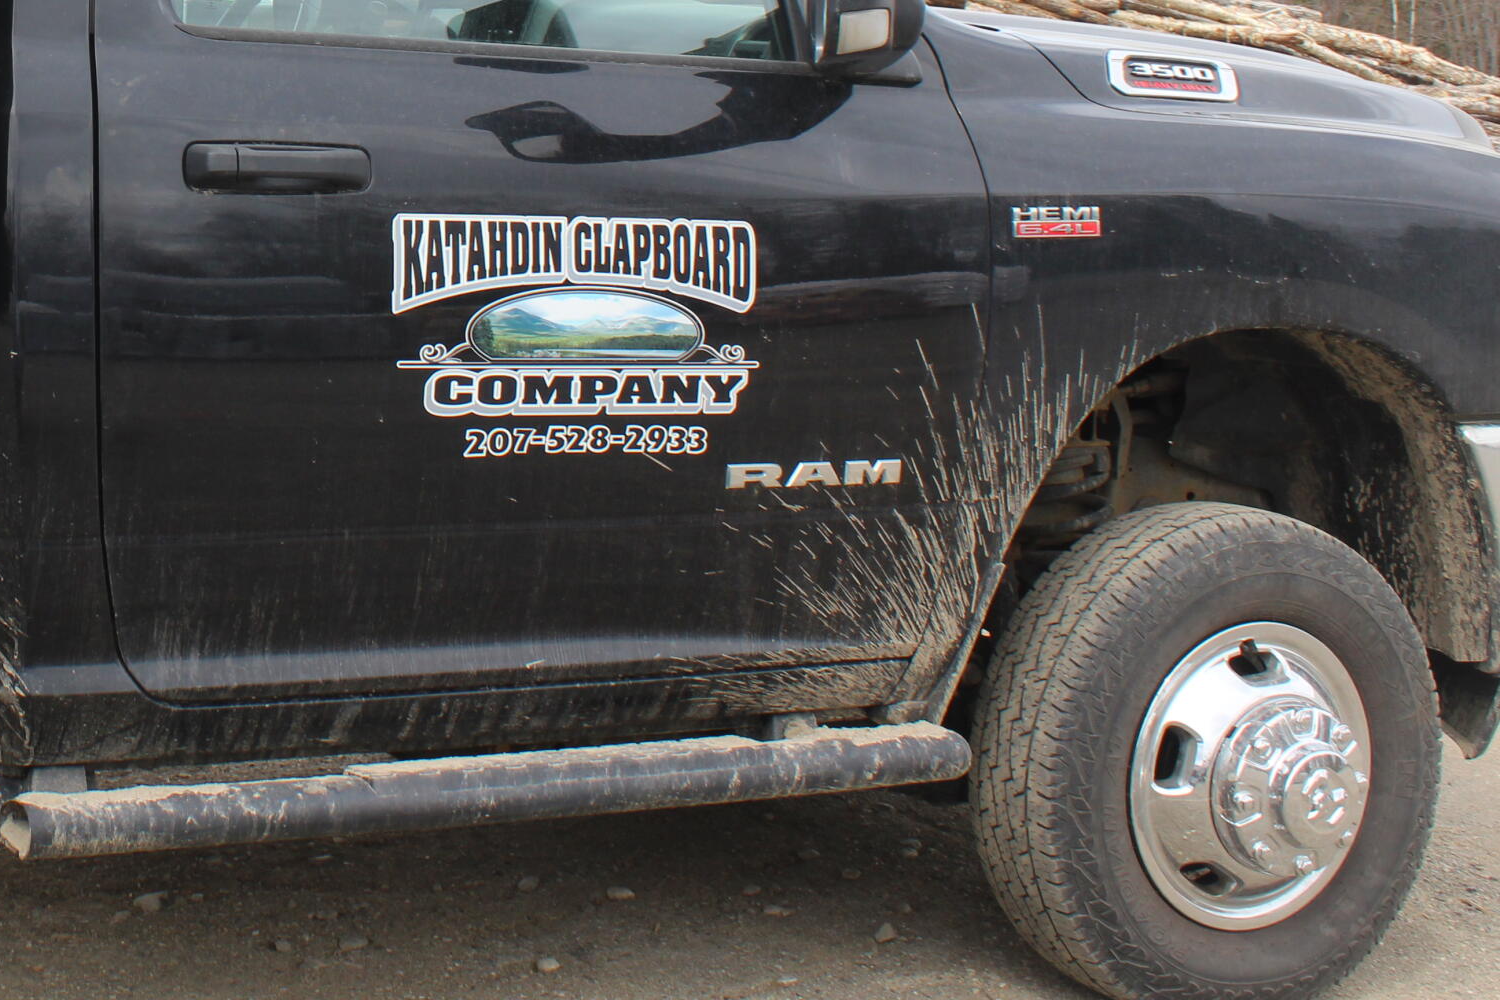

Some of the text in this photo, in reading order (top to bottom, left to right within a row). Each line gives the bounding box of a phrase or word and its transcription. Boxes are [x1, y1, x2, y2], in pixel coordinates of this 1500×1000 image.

[1128, 61, 1216, 83] 3500
[1011, 206, 1100, 222] HEMI
[1018, 223, 1096, 235] 6.4L
[397, 216, 753, 307] KATAHDIN CLAPBOARD
[428, 370, 746, 409] COMPANY
[463, 424, 708, 459] 207-528-2933
[725, 459, 902, 490] RAM
